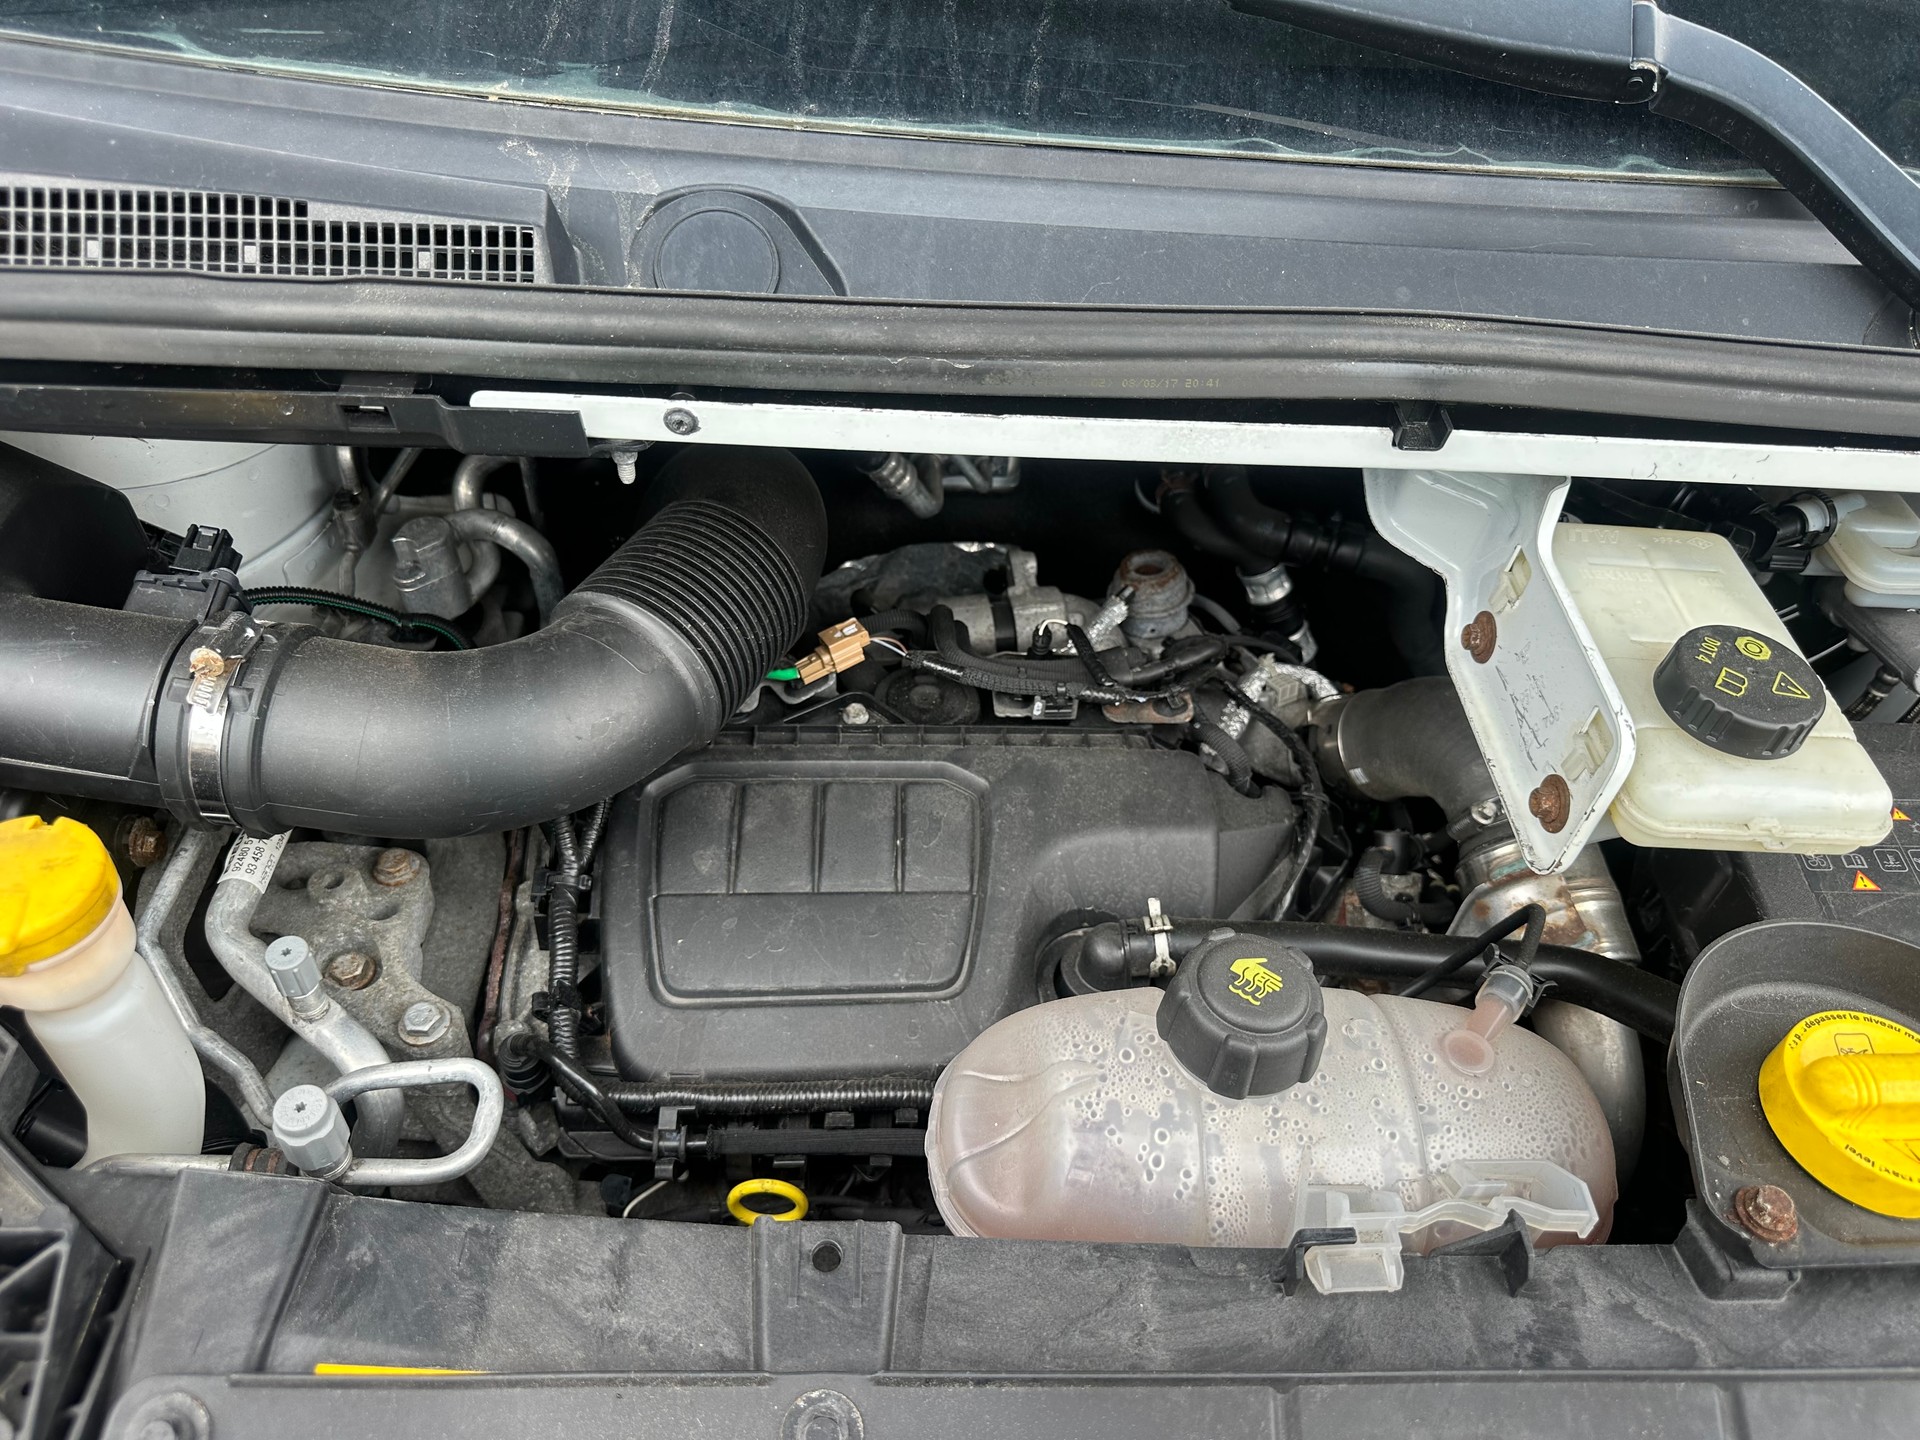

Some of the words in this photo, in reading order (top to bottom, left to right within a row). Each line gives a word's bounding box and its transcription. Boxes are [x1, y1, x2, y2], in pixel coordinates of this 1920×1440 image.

[1184, 378, 1220, 389] 20:41
[1568, 528, 1620, 544] ITW
[231, 846, 251, 872] 92480
[244, 862, 258, 876] 93
[251, 845, 266, 863] 458
[1848, 1012, 1860, 1021] le
[1863, 1015, 1901, 1033] niveau
[1844, 1143, 1875, 1168] level
